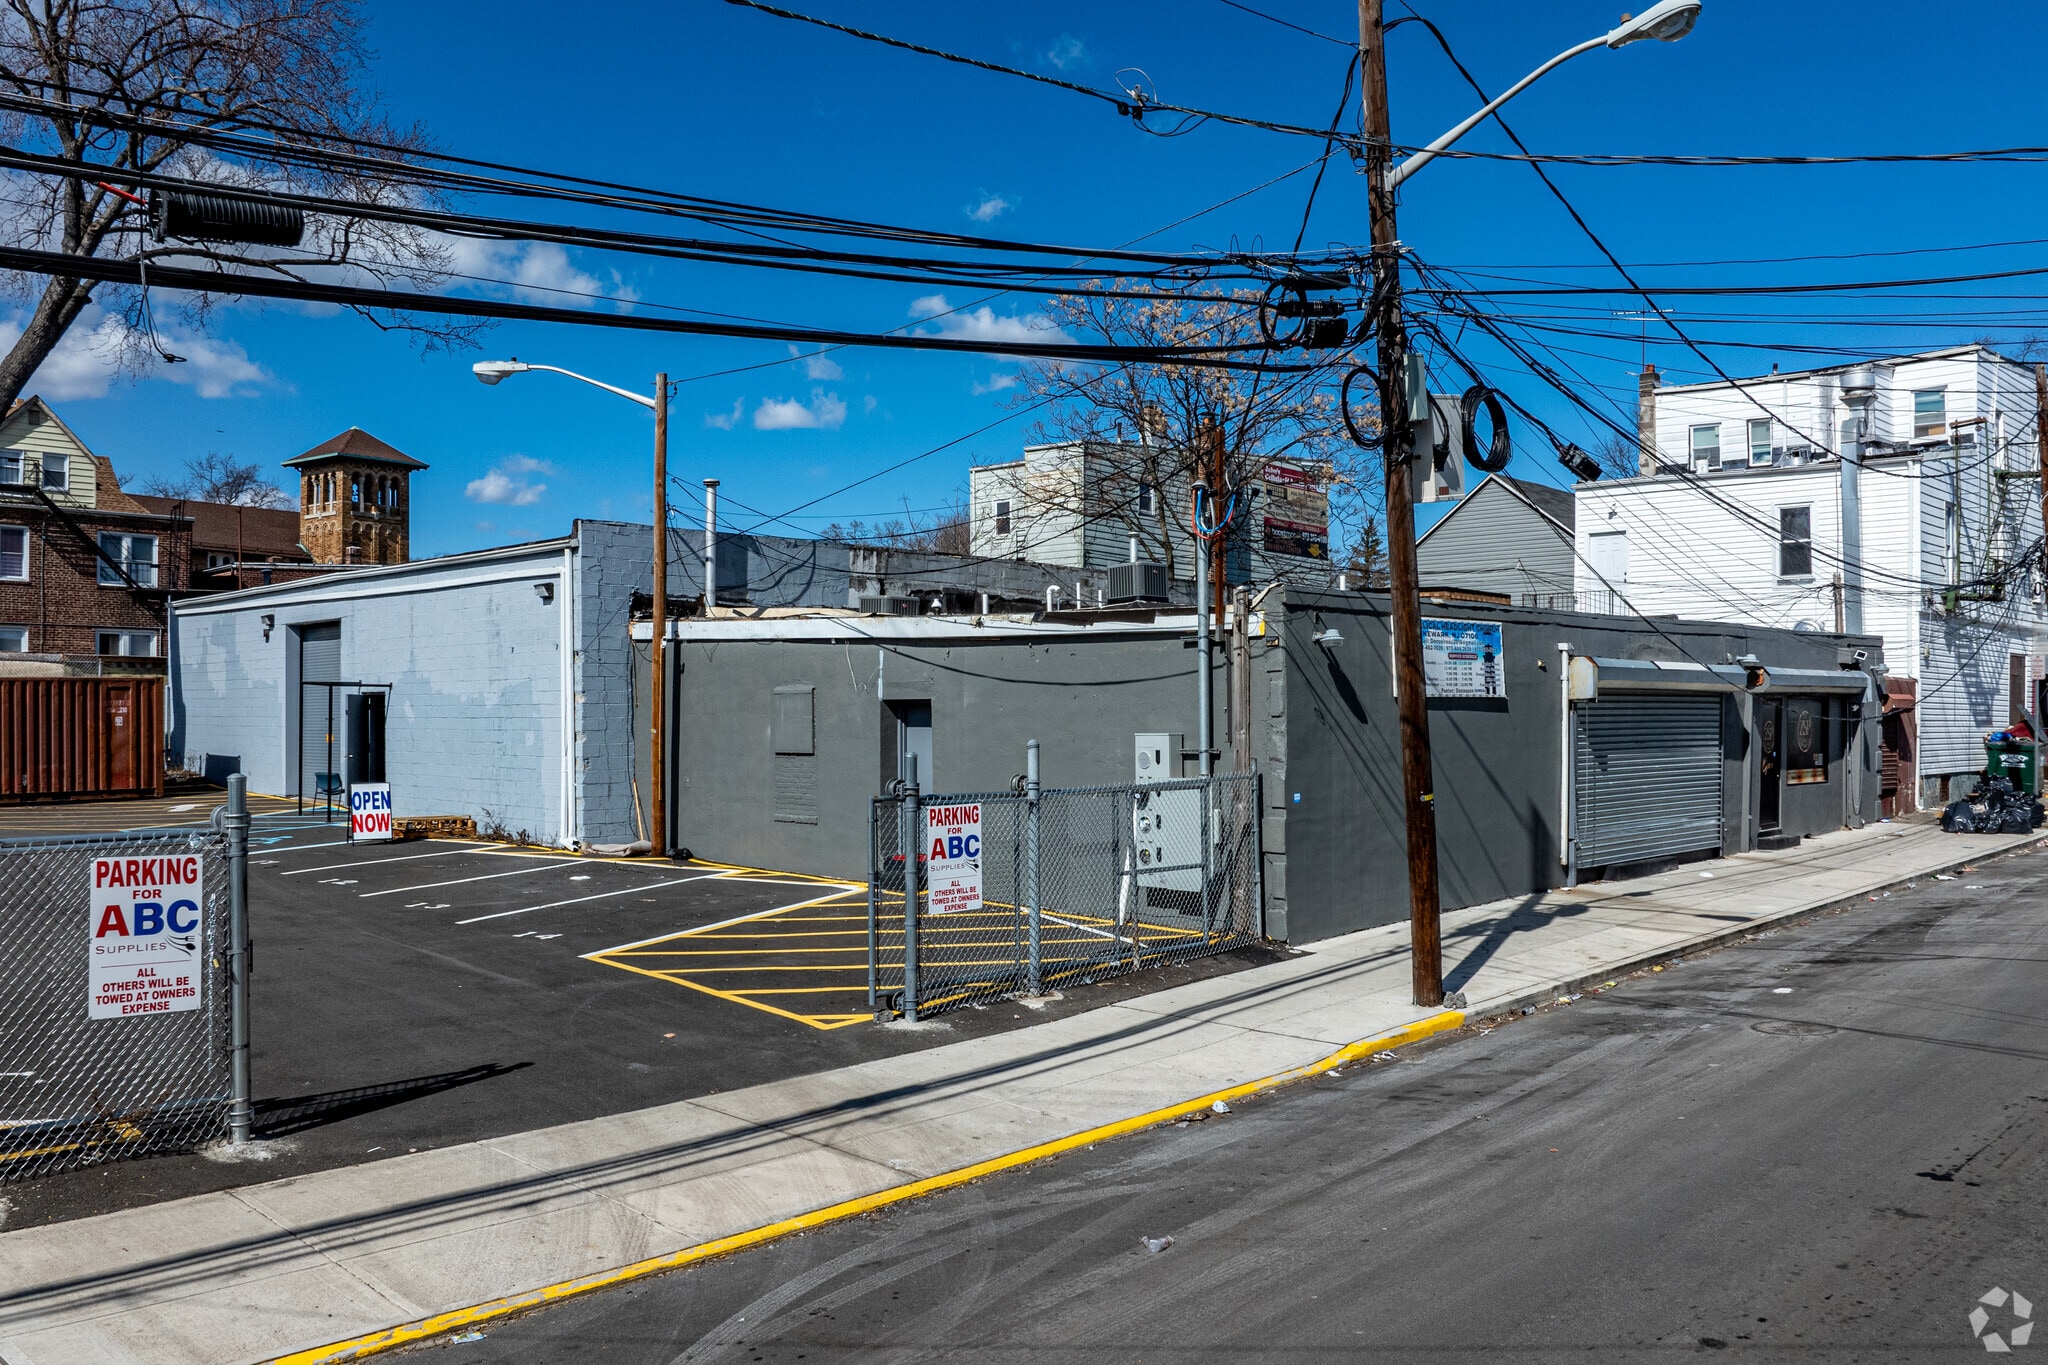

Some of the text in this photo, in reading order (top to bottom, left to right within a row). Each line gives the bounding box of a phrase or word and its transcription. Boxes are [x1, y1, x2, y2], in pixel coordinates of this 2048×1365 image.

[1442, 621, 1475, 631] HEADLIGHT
[352, 791, 390, 811] OPEN
[930, 806, 979, 827] PARKING
[352, 813, 390, 833] NOW
[930, 834, 980, 860] ABC
[96, 857, 197, 888] PARKING
[930, 863, 965, 872] SUPPLIES
[133, 889, 162, 899] FOR
[935, 888, 955, 897] OTHERS
[958, 894, 980, 903] OWNERS
[944, 903, 967, 911] EXPENSE
[95, 900, 199, 938] ABC
[512, 931, 563, 939] 14
[95, 942, 167, 954] SUPPLIES
[137, 968, 156, 977] ALL
[102, 976, 189, 993] OTHERS WILL BE
[96, 988, 196, 1005] TOWED AT OWNERS
[122, 1001, 170, 1014] EXPENSE
